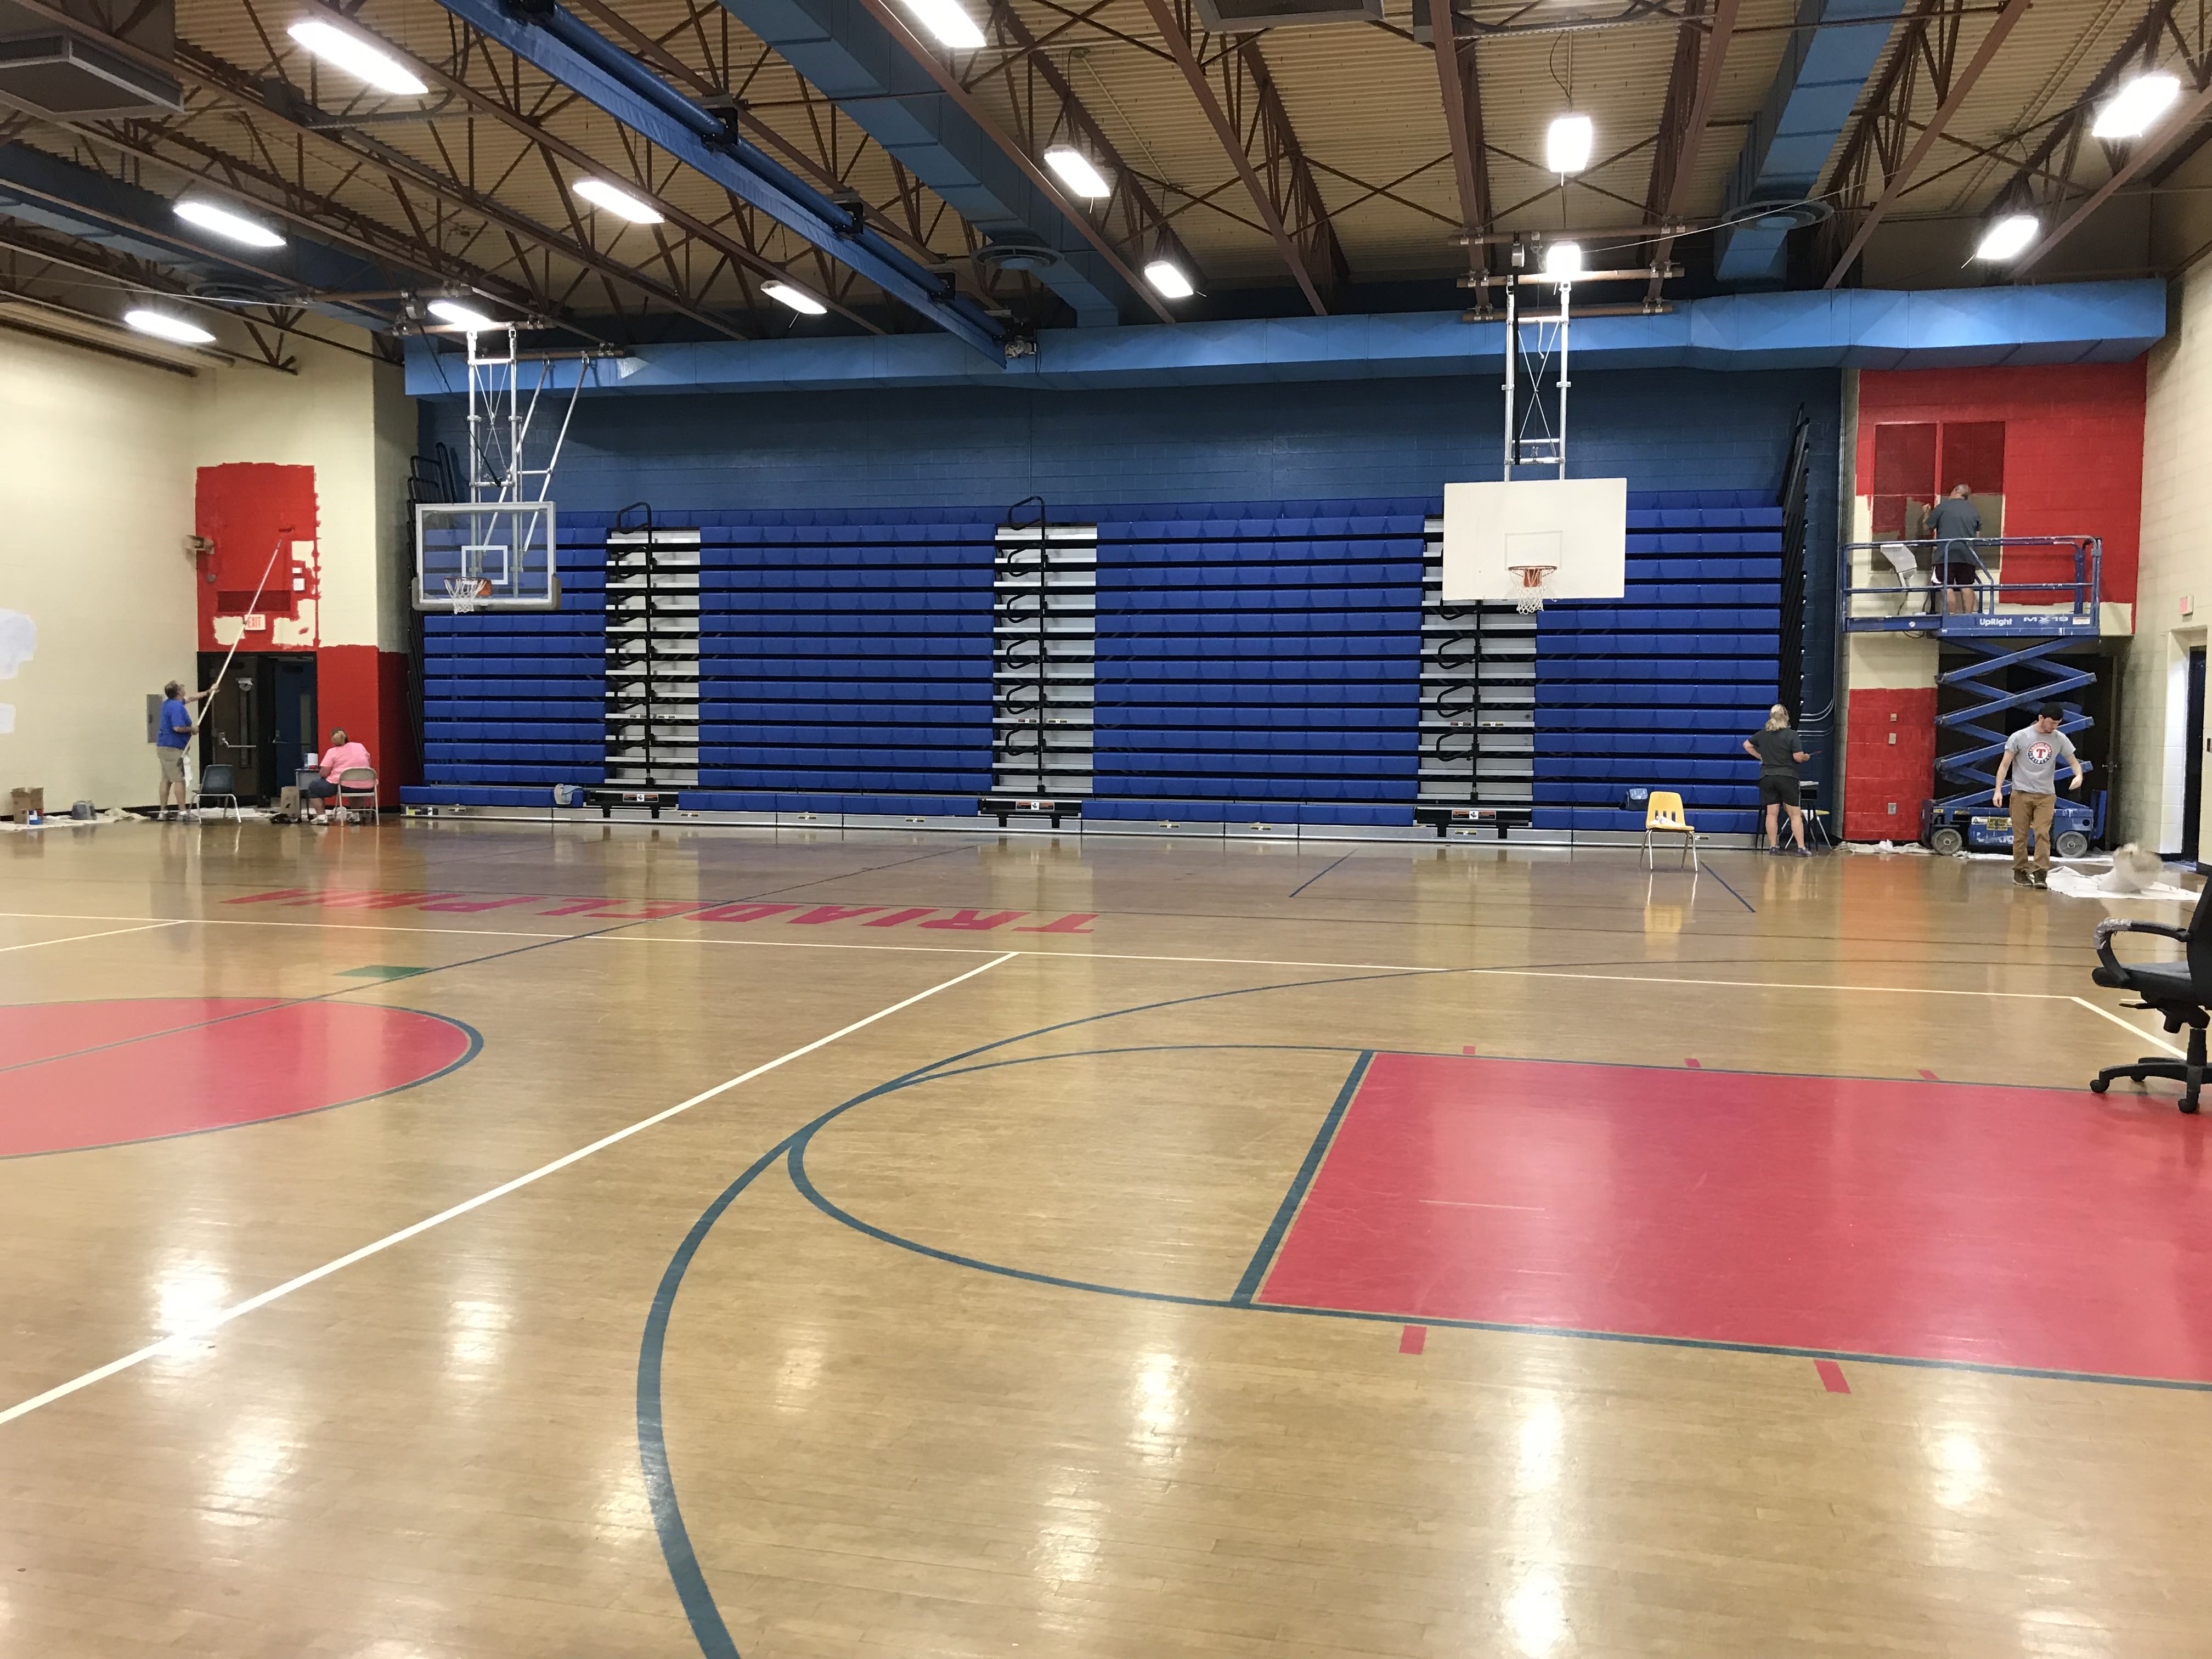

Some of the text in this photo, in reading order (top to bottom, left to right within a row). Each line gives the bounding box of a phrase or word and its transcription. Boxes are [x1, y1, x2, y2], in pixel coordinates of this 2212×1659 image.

[248, 617, 261, 628] EXIT
[2036, 748, 2046, 758] T
[219, 889, 1099, 933] TRIADELPHIA
